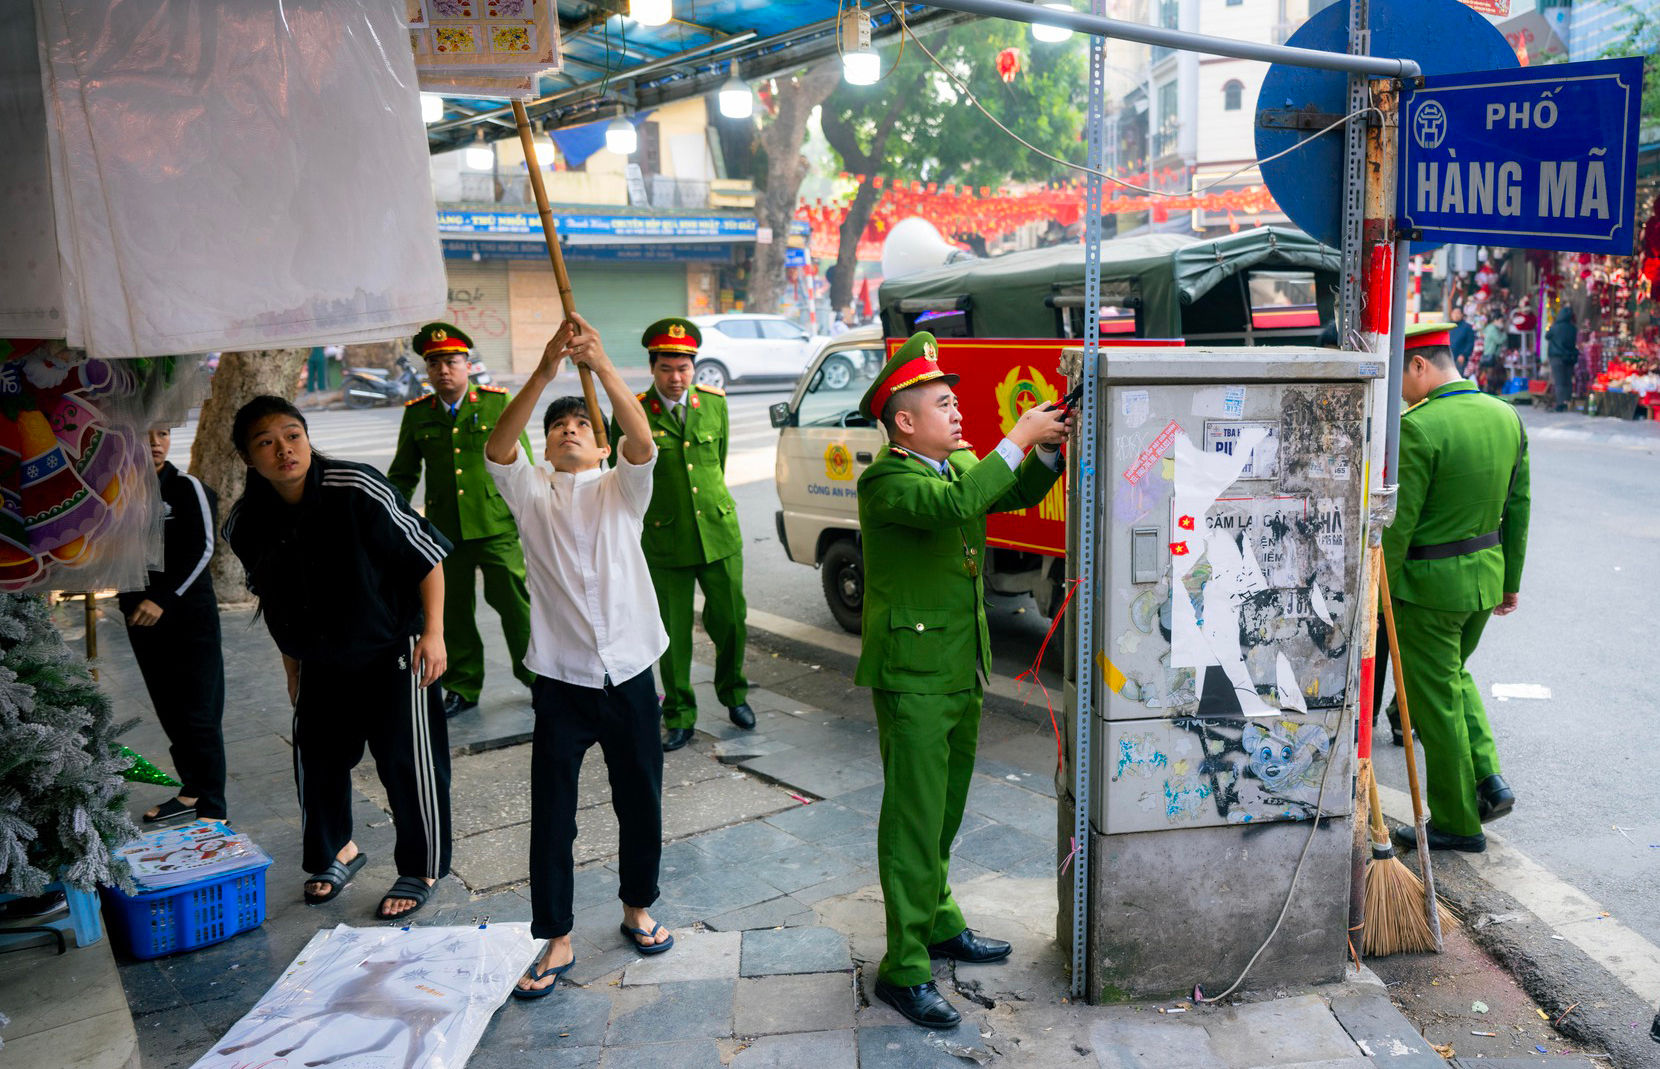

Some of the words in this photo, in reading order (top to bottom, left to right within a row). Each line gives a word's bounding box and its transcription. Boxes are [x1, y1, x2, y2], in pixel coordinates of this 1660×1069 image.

[1485, 85, 1564, 130] PHỐ
[1416, 147, 1523, 217] HÀNG
[1537, 146, 1610, 220] MÃ
[1223, 428, 1236, 437] TBA
[808, 482, 830, 496] CÔNG
[832, 487, 844, 497] AN
[1205, 511, 1234, 529] CẤM
